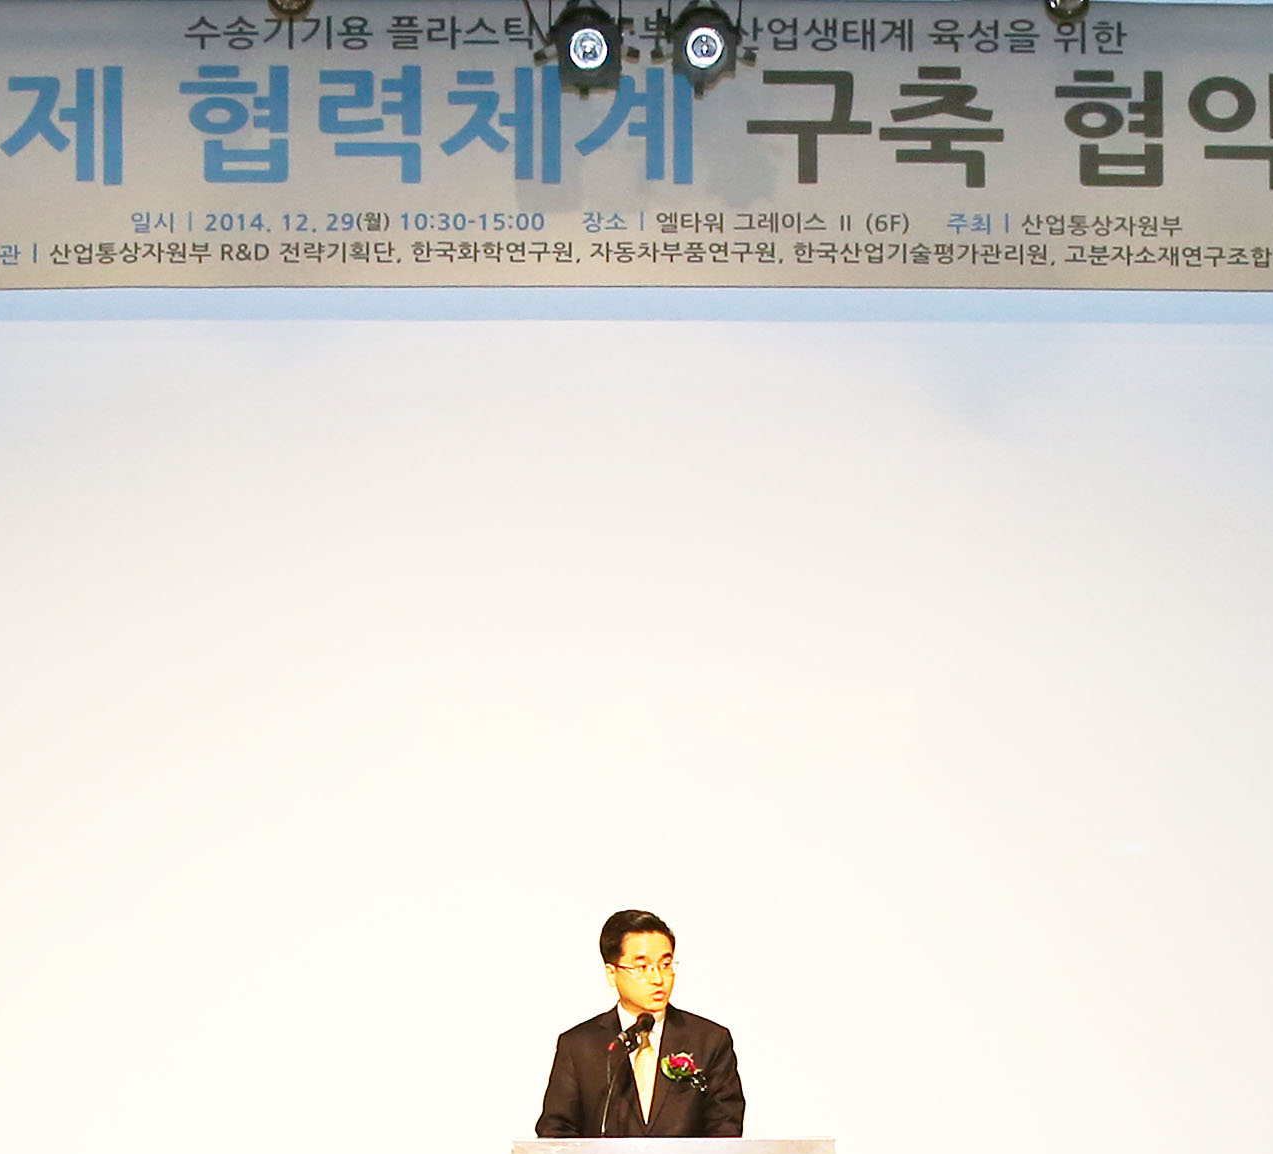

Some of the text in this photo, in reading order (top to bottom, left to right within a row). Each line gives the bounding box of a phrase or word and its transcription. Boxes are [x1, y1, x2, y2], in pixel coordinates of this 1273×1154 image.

[184, 15, 374, 51] 수송기기용
[390, 15, 538, 51] 플라스틱
[927, 18, 1040, 54] 육성을
[1053, 19, 1128, 55] 위한
[179, 65, 693, 184] 협력체계
[746, 66, 1005, 189] 구축
[130, 211, 545, 234] 일시 2014. 12. 29(월) 10:30-15:00
[582, 211, 628, 234] 장소
[655, 211, 724, 234] 엘타워
[733, 211, 827, 235] 그레이스
[865, 212, 910, 236] (6F)
[946, 213, 1183, 238] 주최 산업통상자원부
[49, 241, 212, 265] 산업통상자원부
[220, 242, 270, 262] R&D
[279, 240, 402, 264] 전략기획단,
[410, 240, 581, 264] 한국화학연구원,
[589, 241, 784, 265] 자동차부품연구원,
[793, 241, 1056, 267] 한국산업기술평가관리원,
